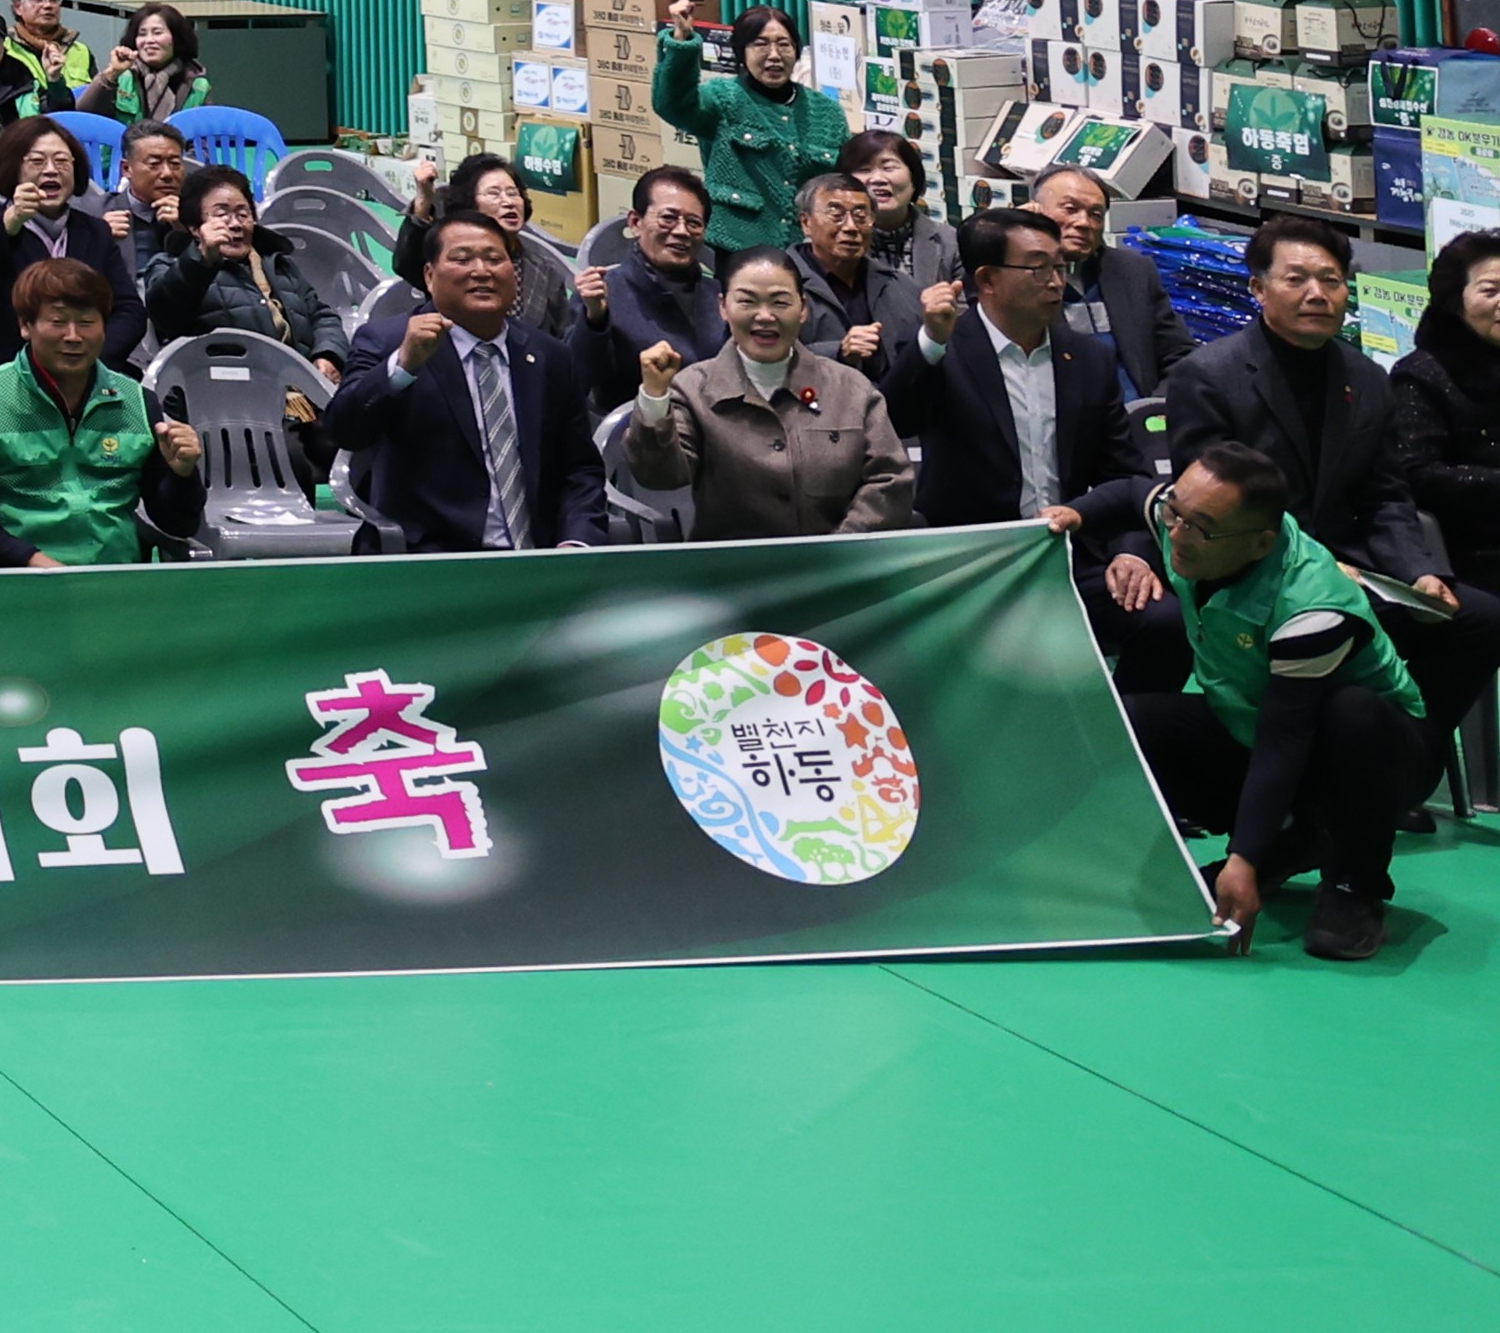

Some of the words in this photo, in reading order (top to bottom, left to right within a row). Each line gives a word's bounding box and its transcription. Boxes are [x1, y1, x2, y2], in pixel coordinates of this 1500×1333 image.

[1241, 127, 1310, 156] 하동축협
[524, 155, 563, 176] 하동수협
[731, 718, 826, 752] 별천지
[286, 669, 493, 859] 축
[742, 750, 842, 802] 하동
